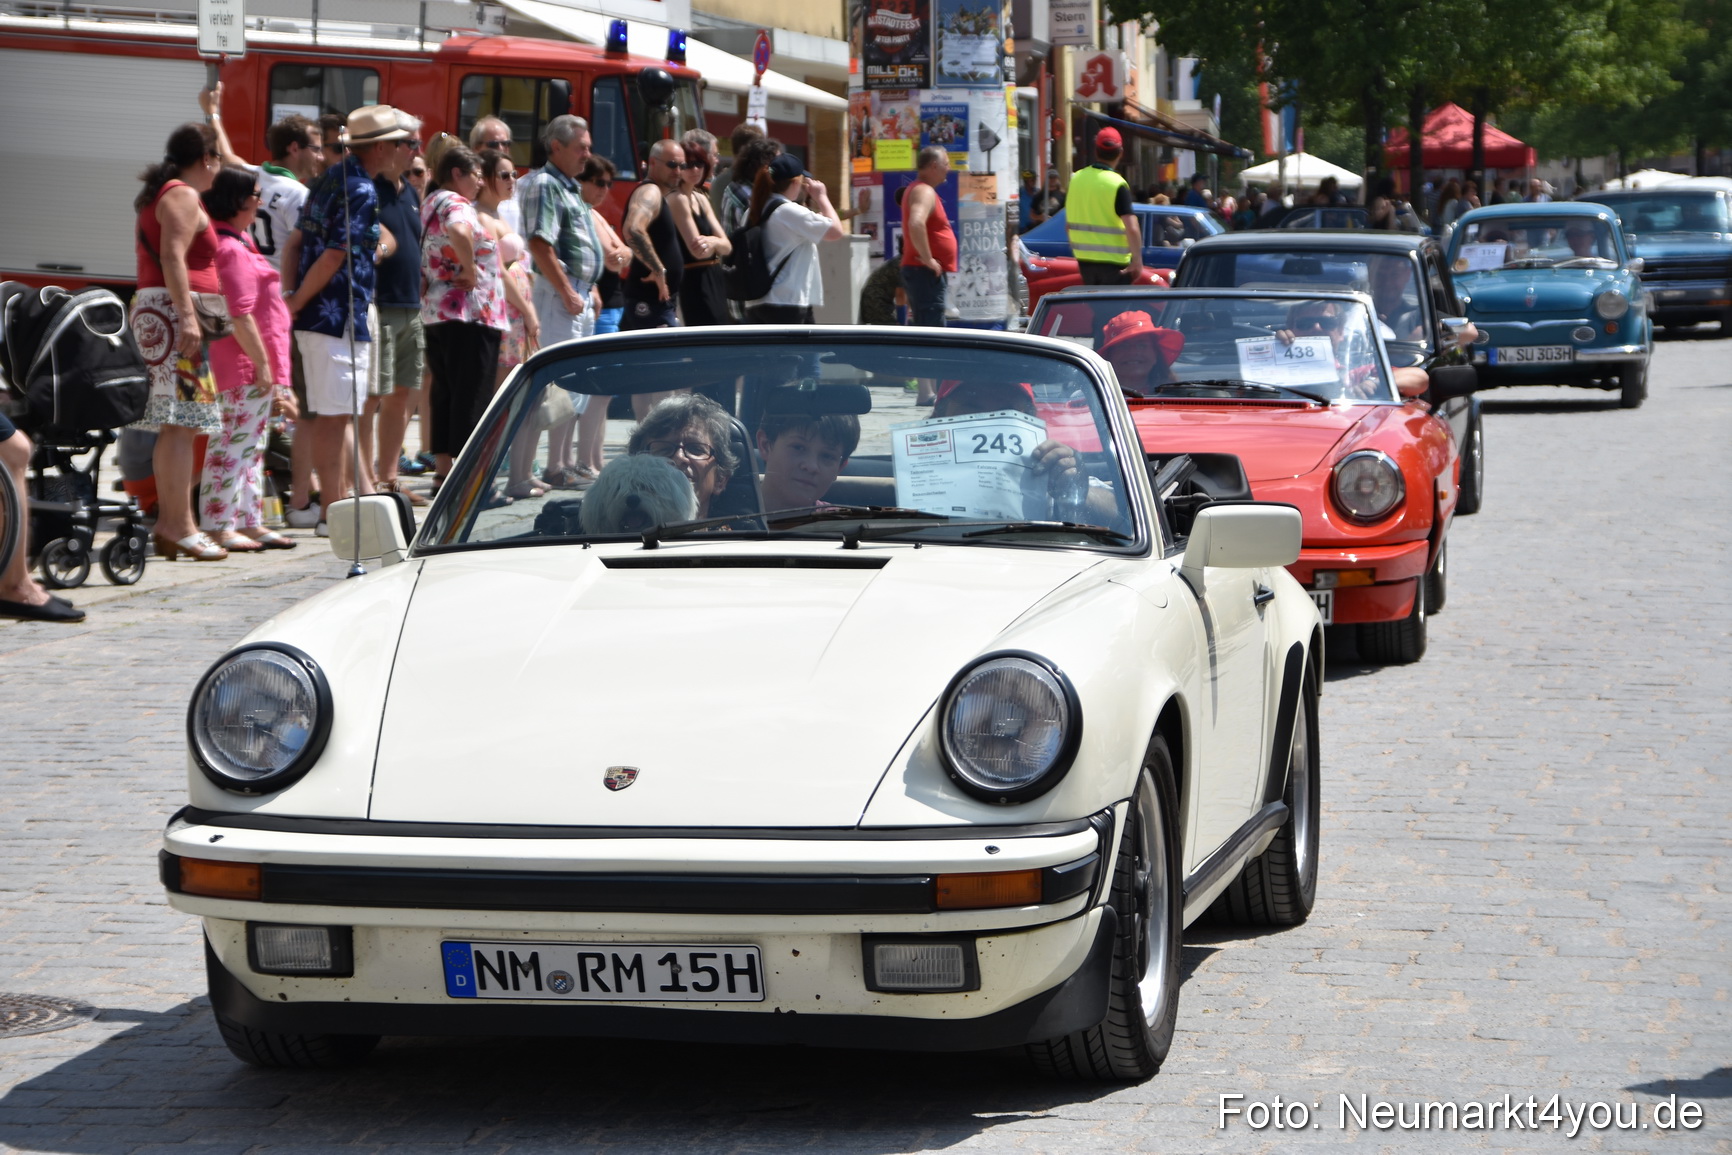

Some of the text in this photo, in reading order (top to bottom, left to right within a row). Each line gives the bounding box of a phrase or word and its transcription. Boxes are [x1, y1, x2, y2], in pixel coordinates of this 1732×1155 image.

[209, 9, 234, 26] verkehr
[867, 15, 921, 30] ALTSTADTFEST
[1055, 12, 1086, 21] Stern
[216, 31, 228, 47] frei
[875, 34, 911, 43] AFTER PARTY
[963, 220, 1005, 236] BRASS
[961, 236, 1001, 251] ANDA
[1284, 345, 1315, 359] 438
[1498, 347, 1573, 361] N SU 303H
[971, 432, 1024, 456] 243
[1312, 593, 1329, 619] H
[473, 949, 759, 994] NM RM 15H
[456, 974, 467, 987] D
